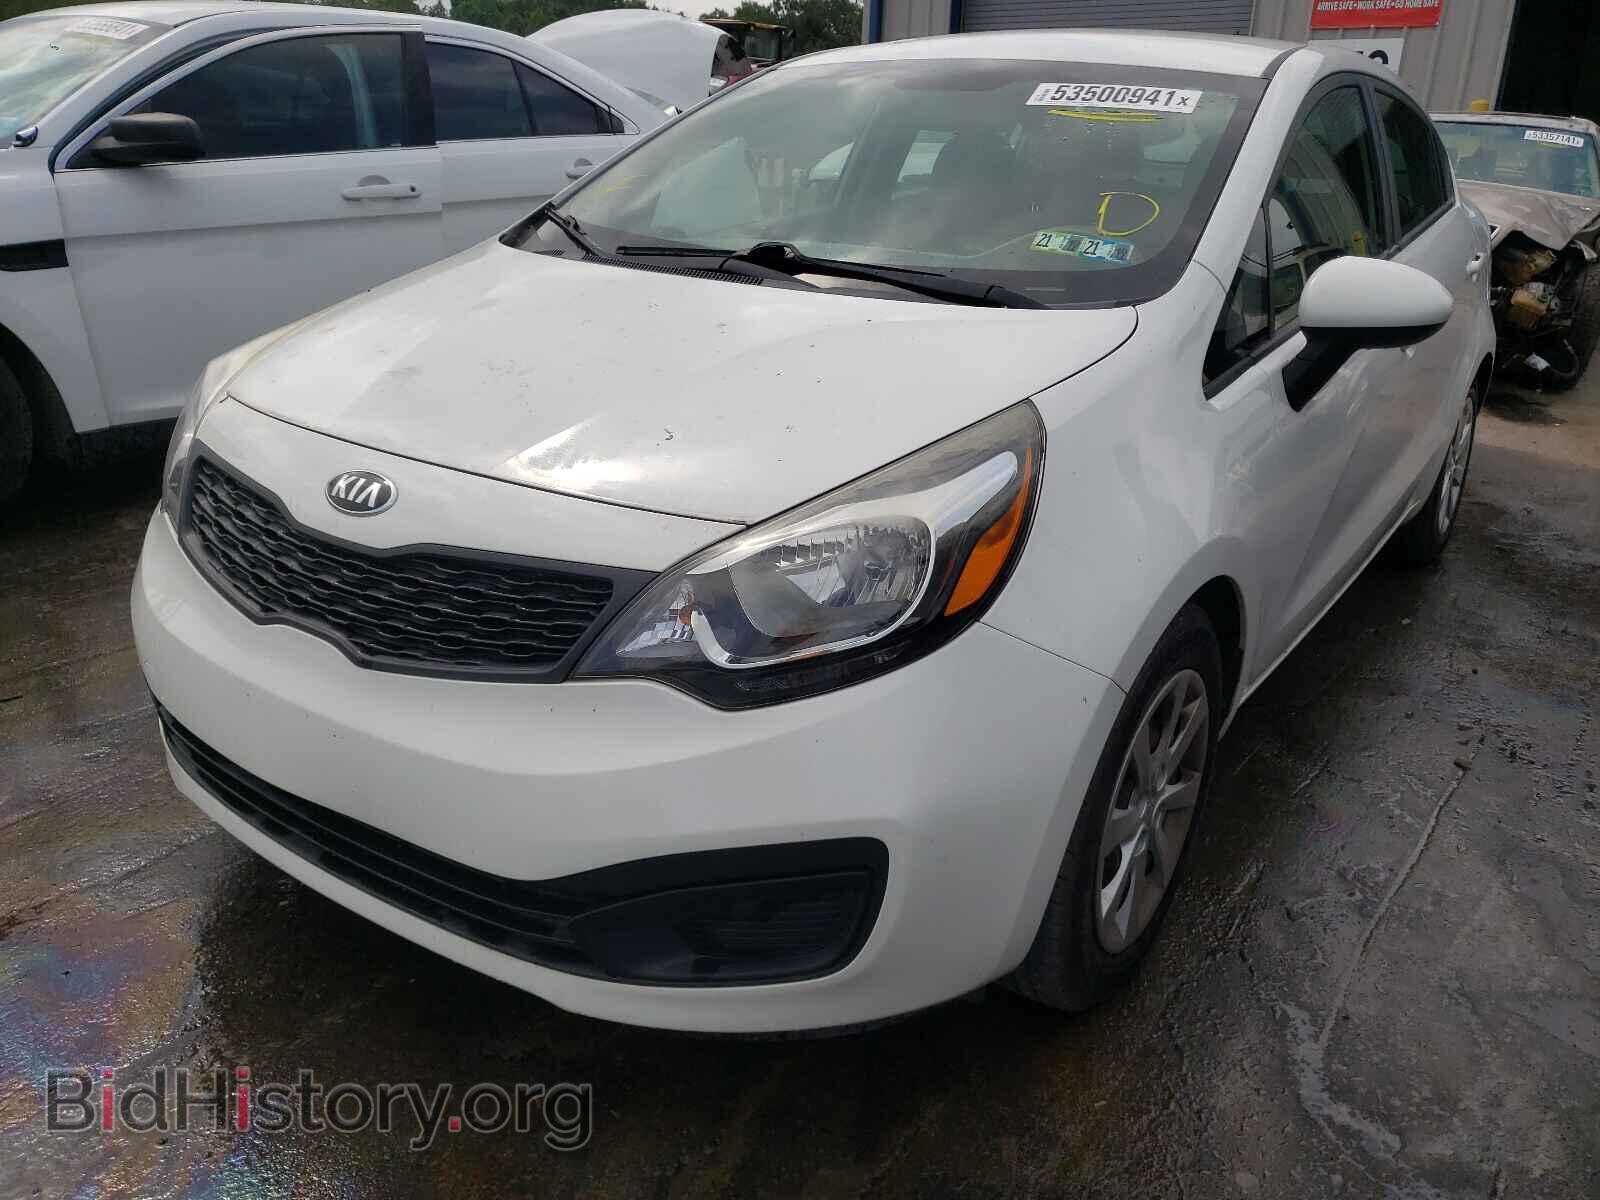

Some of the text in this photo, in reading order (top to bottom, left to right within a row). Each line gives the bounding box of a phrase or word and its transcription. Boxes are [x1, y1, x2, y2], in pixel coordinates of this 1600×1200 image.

[1318, 0, 1338, 10] ARRIVE
[1405, 0, 1422, 8] HOME
[1051, 84, 1177, 106] 53500941
[1097, 191, 1159, 236] D
[1036, 233, 1053, 248] 21
[1083, 240, 1101, 256] 21
[331, 474, 381, 508] KIA
